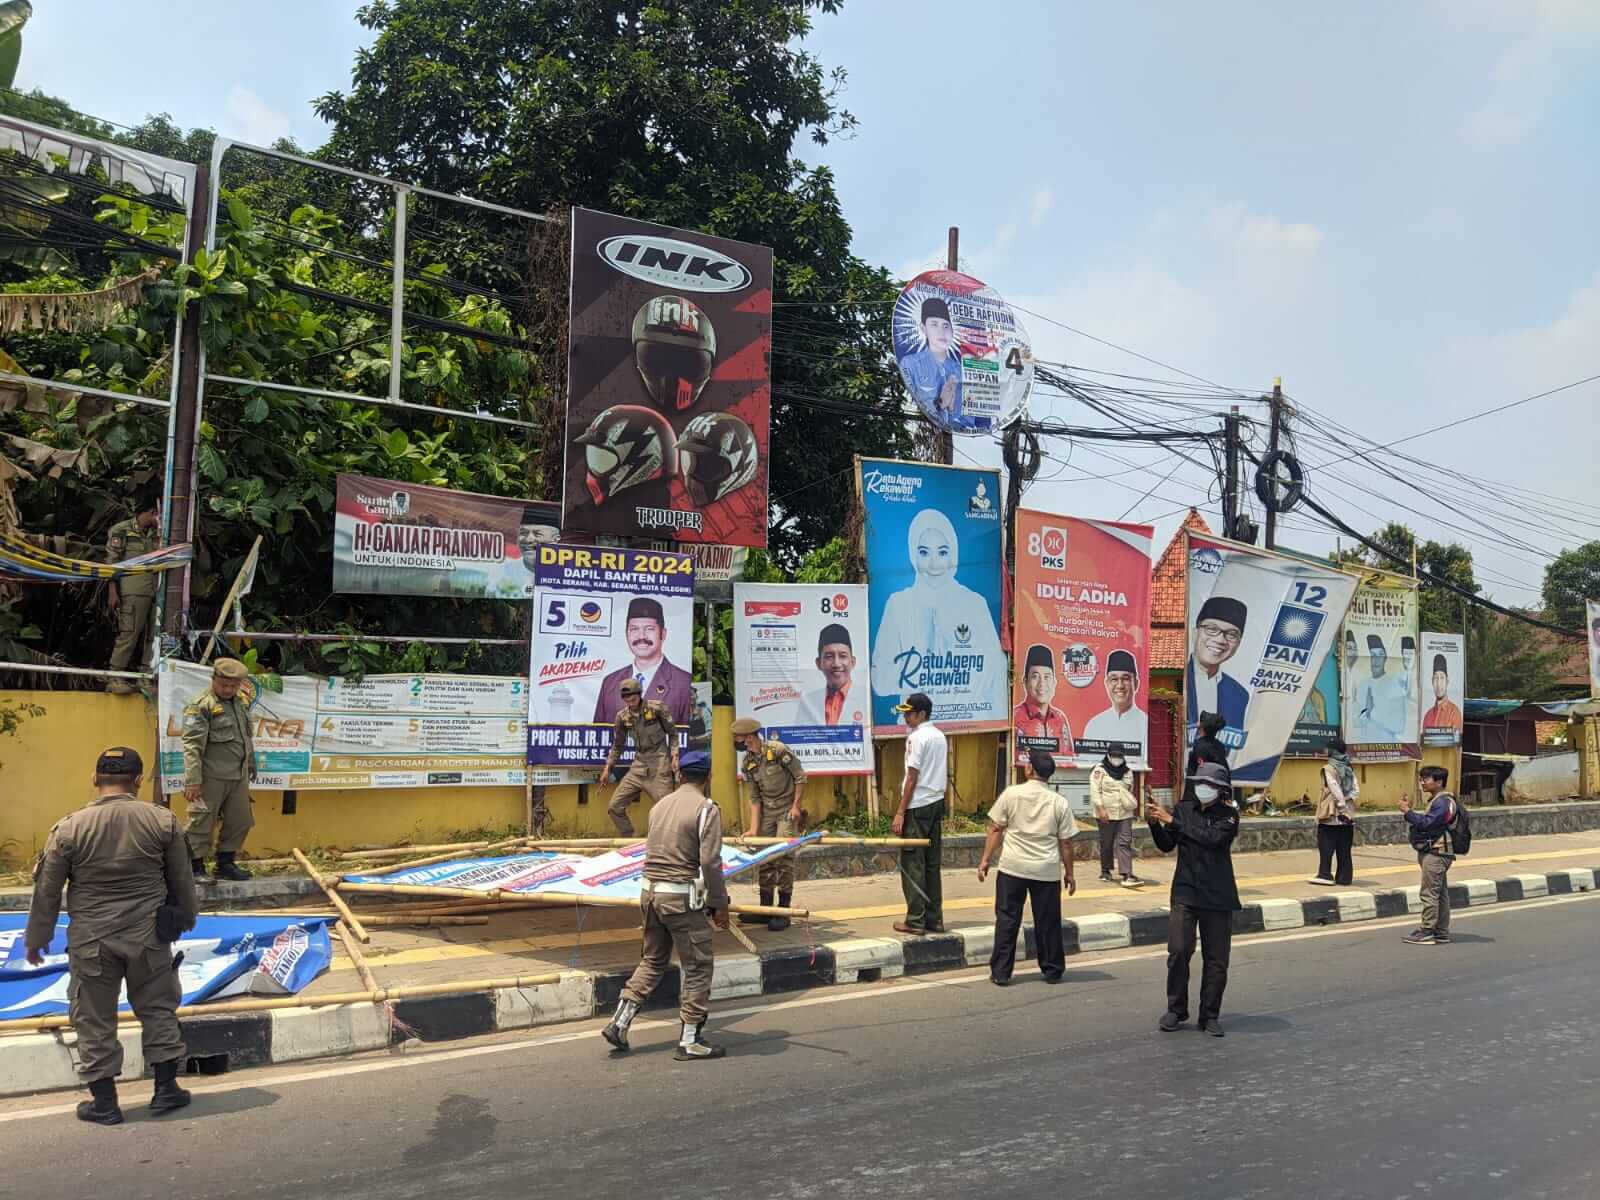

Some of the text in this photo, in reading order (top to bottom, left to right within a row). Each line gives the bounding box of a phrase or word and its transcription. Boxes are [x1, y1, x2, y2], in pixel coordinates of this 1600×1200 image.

[615, 242, 736, 282] INK
[952, 303, 975, 318] DEDE
[1005, 347, 1024, 376] 4
[978, 373, 999, 384] PAN
[897, 474, 922, 489] Ageng
[636, 506, 703, 532] TROOPER
[372, 524, 430, 556] GANJAR
[433, 530, 503, 559] PRANOWO
[1027, 532, 1040, 556] 8
[354, 554, 453, 569] UNTUK INDONESIA
[540, 546, 693, 574] DPR-RI 2024
[1042, 556, 1064, 568] PKS
[1192, 561, 1219, 574] PAN
[564, 568, 668, 584] DAPIL BANTEN II
[1037, 583, 1128, 606] IDUL ADHA
[1295, 582, 1328, 608] 12
[546, 600, 566, 627] 5
[821, 598, 831, 613] 8
[1373, 599, 1405, 616] Fitri
[1059, 616, 1104, 627] Kurban Kita
[1043, 624, 1119, 638] Bahagiakan Rakyat
[555, 641, 587, 659] Pilih
[1265, 644, 1309, 666] PAN
[540, 659, 606, 678] AKADEMISI
[944, 651, 984, 672] Ageng
[1256, 668, 1302, 684] BANTU
[410, 678, 423, 693] 2
[511, 681, 521, 694] 3
[1250, 678, 1303, 694] RAKYAT
[321, 717, 335, 731] 4
[408, 719, 419, 732] 5
[507, 720, 518, 733] 6
[531, 729, 561, 746] PROF.
[563, 730, 583, 746] DR.
[584, 731, 600, 746] IR.
[600, 731, 612, 747] H.
[557, 748, 589, 761] YUSUF,
[319, 757, 331, 770] 7
